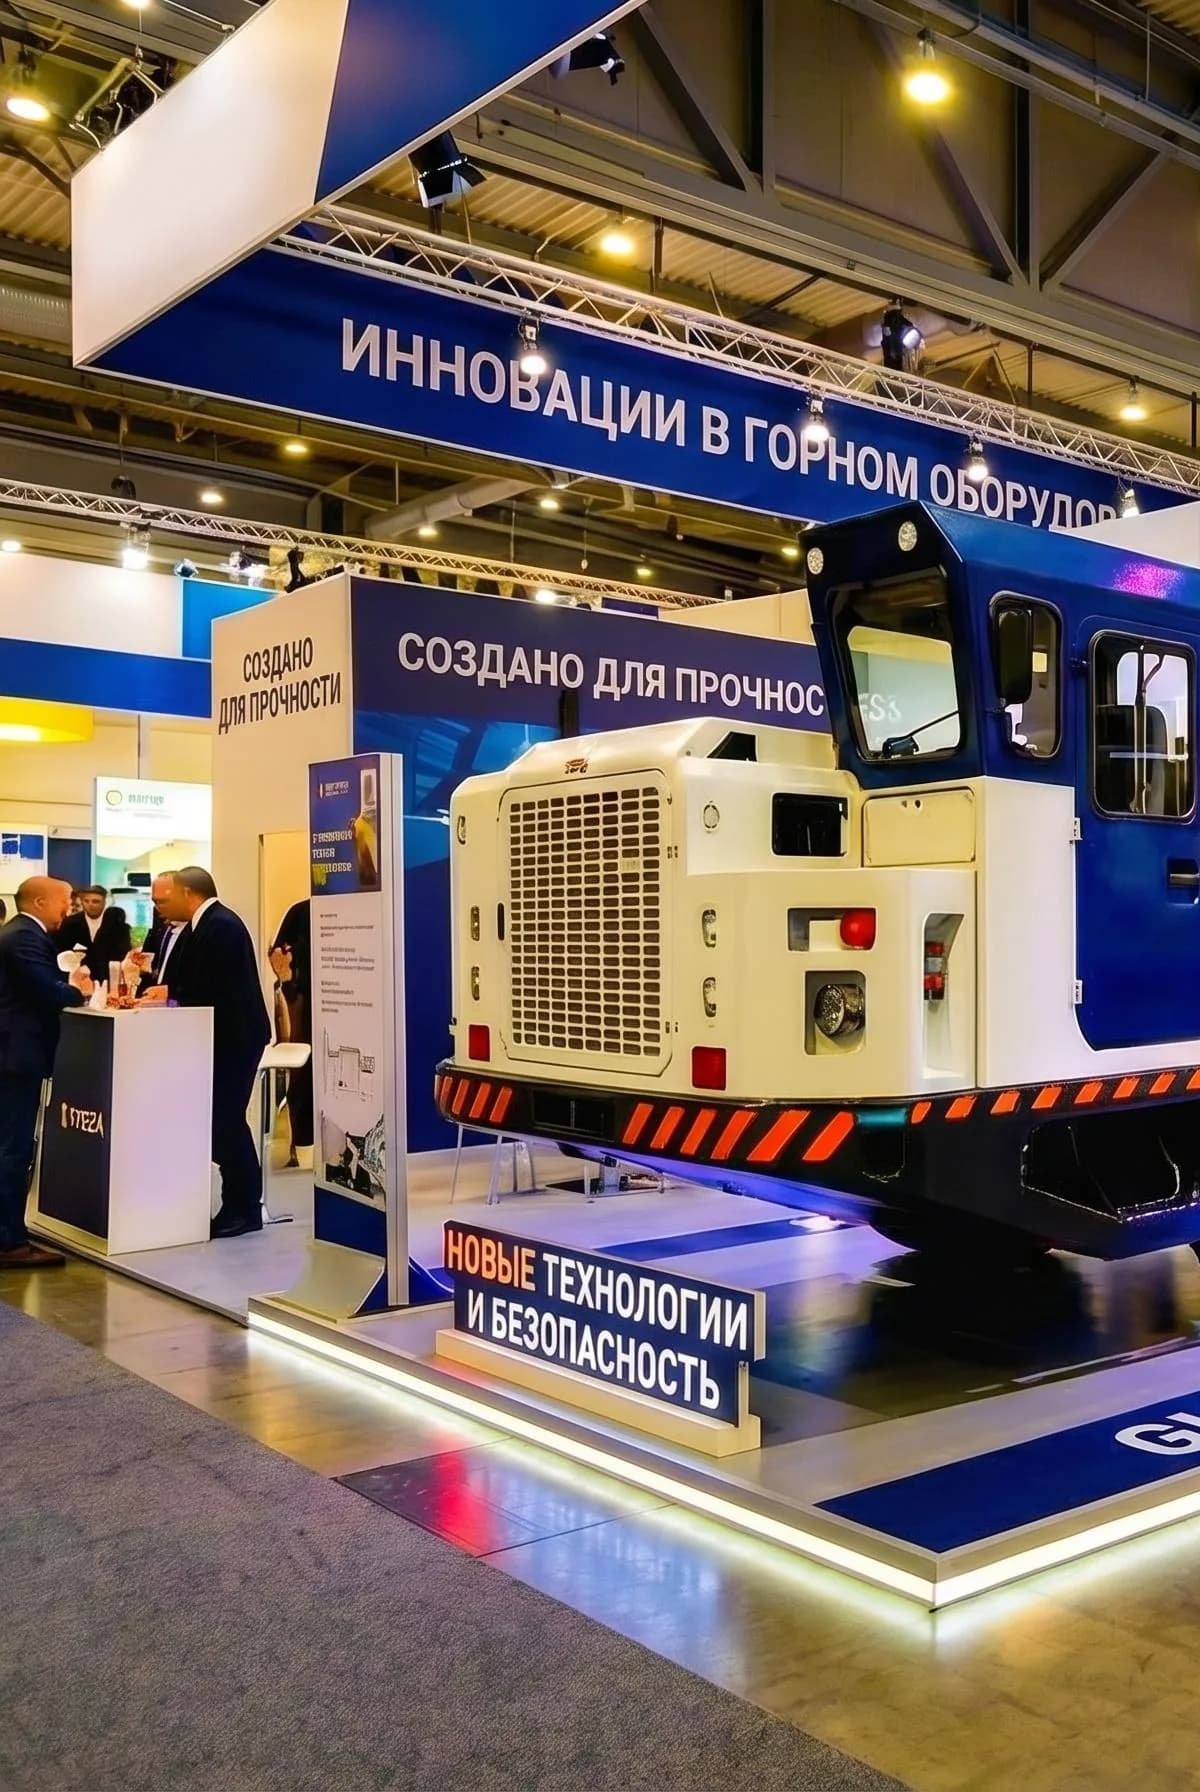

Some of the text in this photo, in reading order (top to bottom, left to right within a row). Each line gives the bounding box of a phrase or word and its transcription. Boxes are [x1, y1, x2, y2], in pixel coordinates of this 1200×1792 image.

[342, 319, 686, 447] ИННОВАЦИИ
[702, 406, 729, 455] В
[745, 416, 918, 501] ГОРНОМ
[218, 672, 341, 735] ДЛЯ ПРОЧНОСТИ
[243, 637, 314, 683] СОЗДАНО
[398, 632, 584, 688] СОЗДАНО
[593, 657, 665, 701] ДЛЯ
[447, 1229, 748, 1350] НОВЫЕ ТЕХНОЛОГИИ
[467, 1289, 720, 1411] И БЕЗОПАСНОСТЬ
